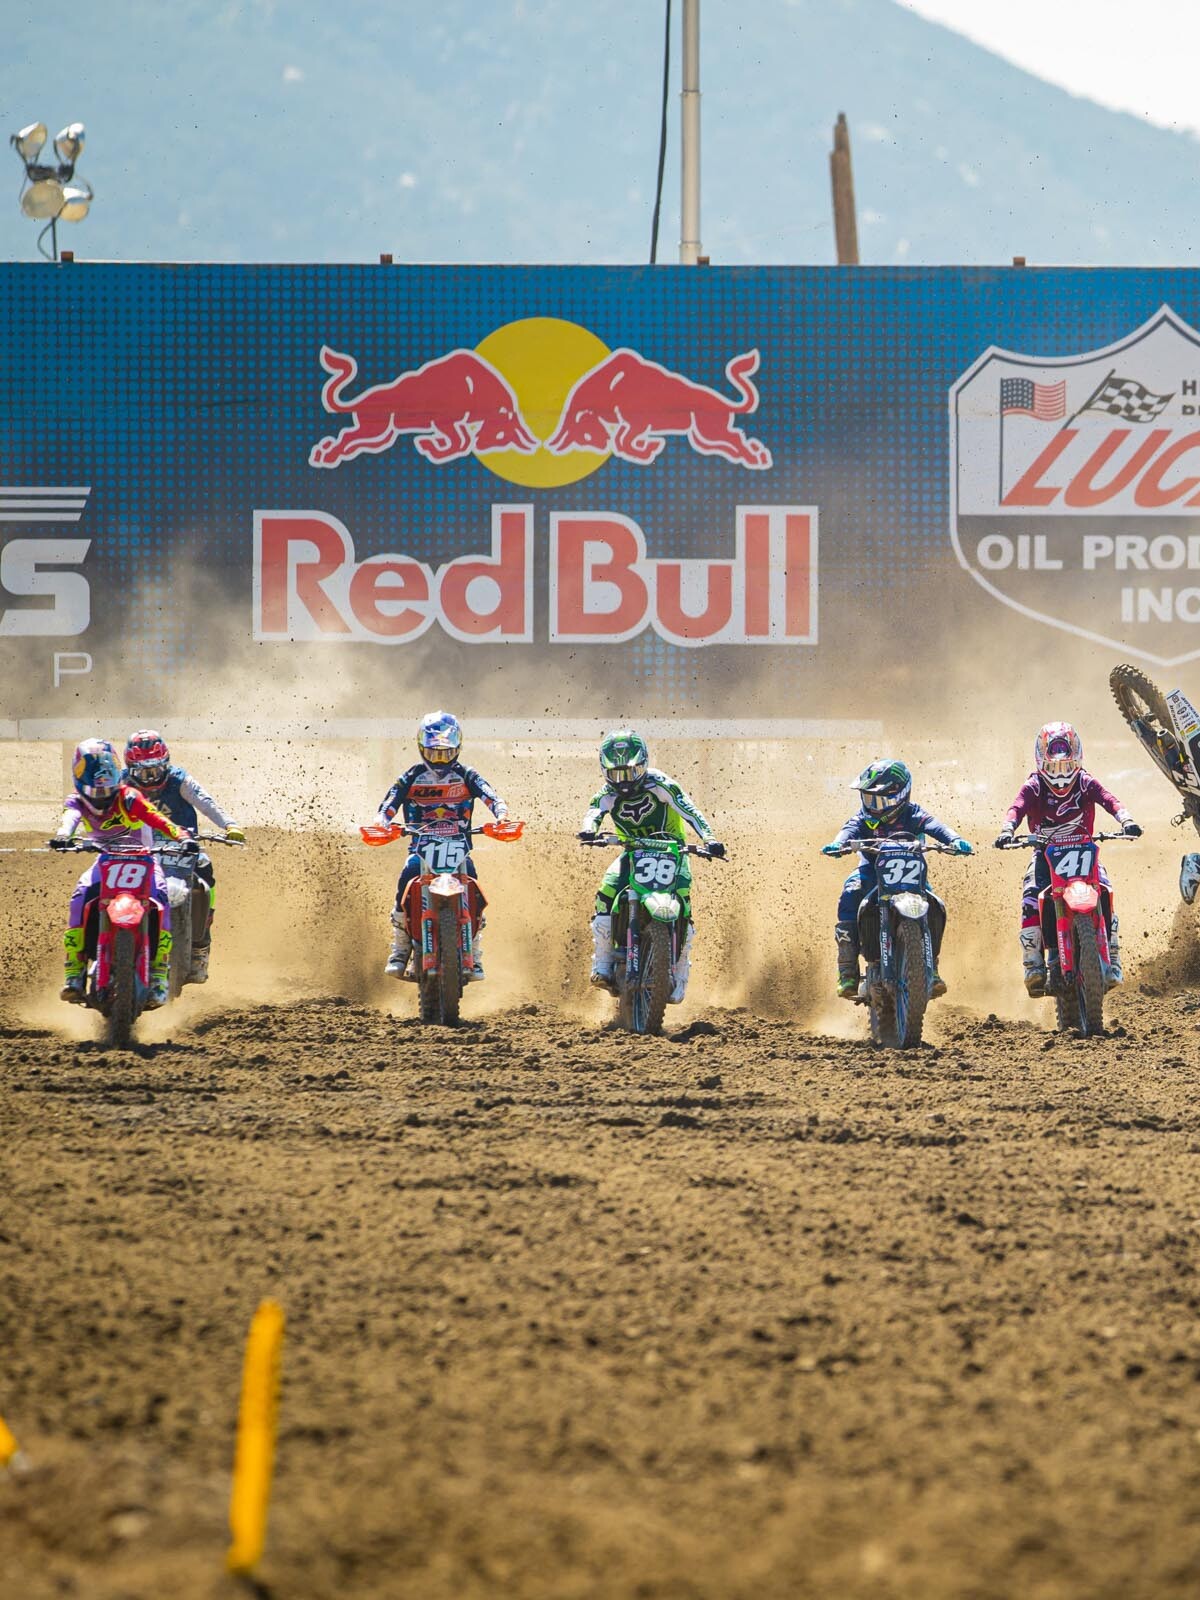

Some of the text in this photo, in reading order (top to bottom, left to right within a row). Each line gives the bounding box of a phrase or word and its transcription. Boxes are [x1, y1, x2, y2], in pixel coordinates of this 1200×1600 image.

[976, 534, 1063, 571] OIL
[254, 504, 819, 647] Red Bull
[53, 653, 92, 687] P
[421, 842, 465, 869] 115
[1055, 850, 1092, 878] 41
[105, 863, 147, 889] 18
[634, 857, 676, 885] 38
[882, 858, 921, 885] 32
